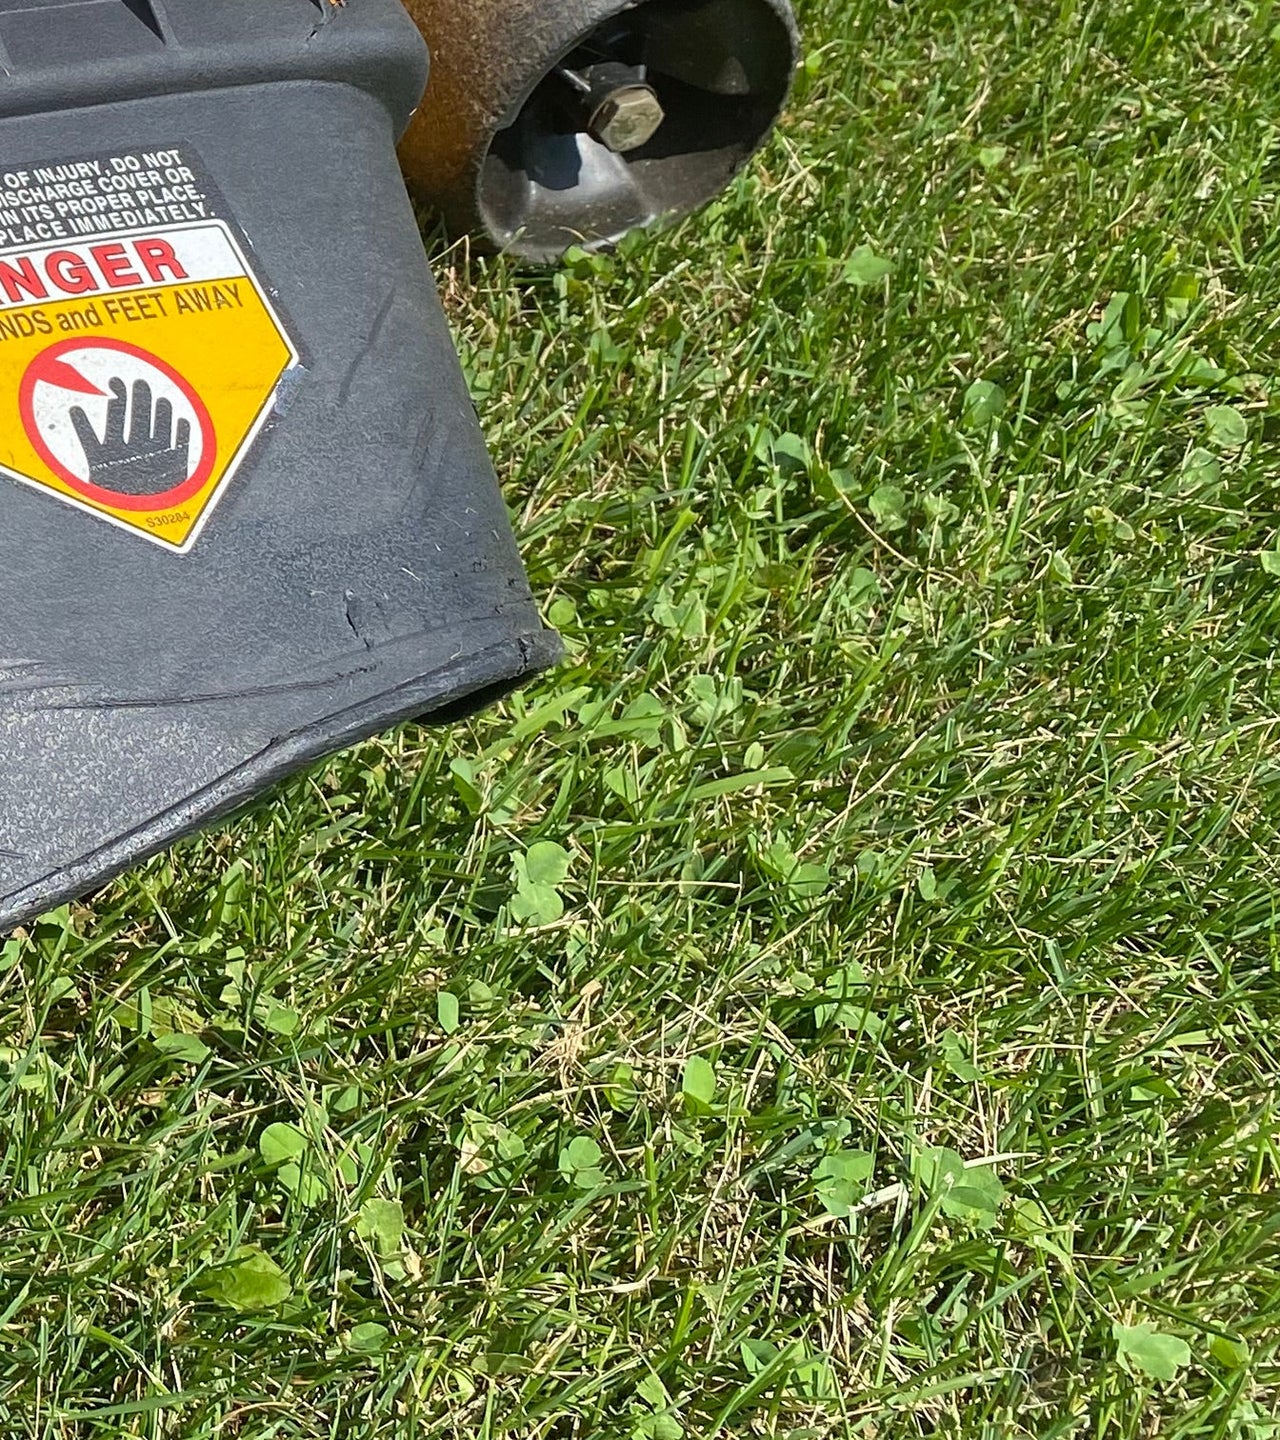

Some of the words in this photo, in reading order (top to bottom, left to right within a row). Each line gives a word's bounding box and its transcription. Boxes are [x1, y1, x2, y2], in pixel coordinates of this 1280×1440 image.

[4, 171, 31, 189] OF
[33, 161, 110, 184] INJURY,
[110, 157, 140, 173] DO
[144, 149, 182, 168] NOT
[98, 171, 163, 193] COVER
[164, 166, 196, 184] OR
[21, 203, 54, 222] ITS
[55, 193, 137, 218] PROPER
[136, 184, 206, 206] PLACE.
[69, 201, 216, 234] IMMEDIATELY.
[57, 304, 101, 332] and
[105, 294, 165, 323] FEET
[176, 284, 245, 311] AWAY
